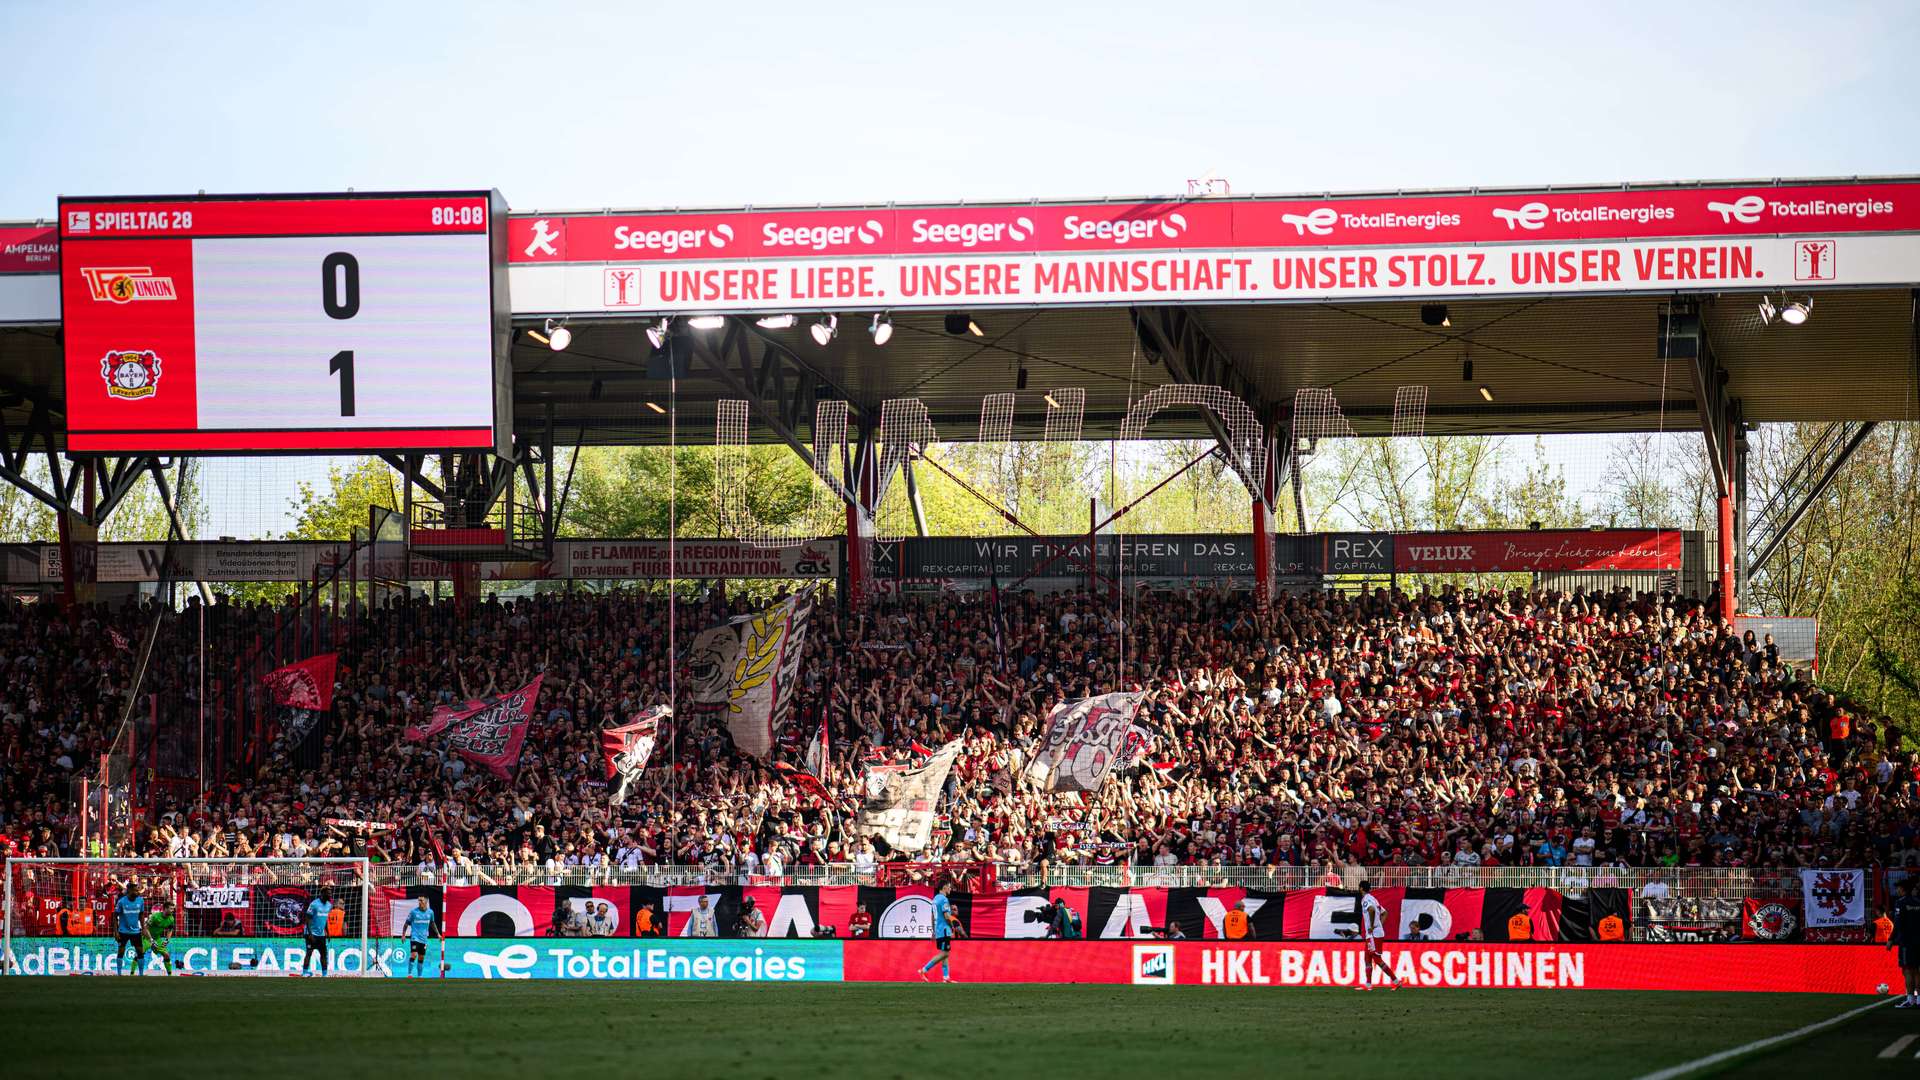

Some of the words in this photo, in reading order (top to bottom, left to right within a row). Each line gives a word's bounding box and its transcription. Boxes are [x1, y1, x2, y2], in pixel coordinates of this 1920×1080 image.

[431, 206, 484, 225] 80:08
[1552, 204, 1676, 224] TotalEnergies
[1768, 197, 1894, 218] TotalEnergies
[95, 211, 169, 230] SPIELTAG
[172, 211, 193, 229] 28
[1063, 214, 1159, 244] Seeger
[1341, 211, 1462, 231] TotalEnergies
[613, 225, 706, 253] Seeger
[762, 221, 856, 250] Seeger
[911, 218, 1006, 247] Seeger
[25, 254, 51, 262] BERLIN
[659, 268, 778, 302] UNSERE
[790, 265, 885, 299] LIEBE.
[899, 263, 1021, 298] UNSERE
[1034, 257, 1258, 294] MANNSCHAFT.
[1272, 256, 1378, 290] UNSER
[1388, 253, 1496, 287] STOLZ.
[1511, 248, 1622, 285] UNSER
[1633, 244, 1765, 281] VEREIN.
[135, 280, 173, 297] UNION
[322, 251, 360, 320] 0
[329, 350, 356, 417] 1
[572, 550, 590, 560] DIE
[591, 545, 658, 560] FLAMME
[682, 545, 740, 560] REGION
[764, 550, 781, 560] DIE
[975, 541, 1019, 559] WIR
[1193, 543, 1246, 557] DAS.
[1408, 545, 1473, 561] VELUX
[1504, 542, 1553, 566] Bringt
[1554, 543, 1594, 560] Licht
[1618, 544, 1668, 559] Leben
[1334, 562, 1385, 571] CAPITAL
[43, 898, 61, 910] Tor
[90, 899, 108, 911] Tor
[894, 925, 934, 934] BAYER
[548, 948, 806, 981] TotalEnergies
[1201, 949, 1271, 984] HKL
